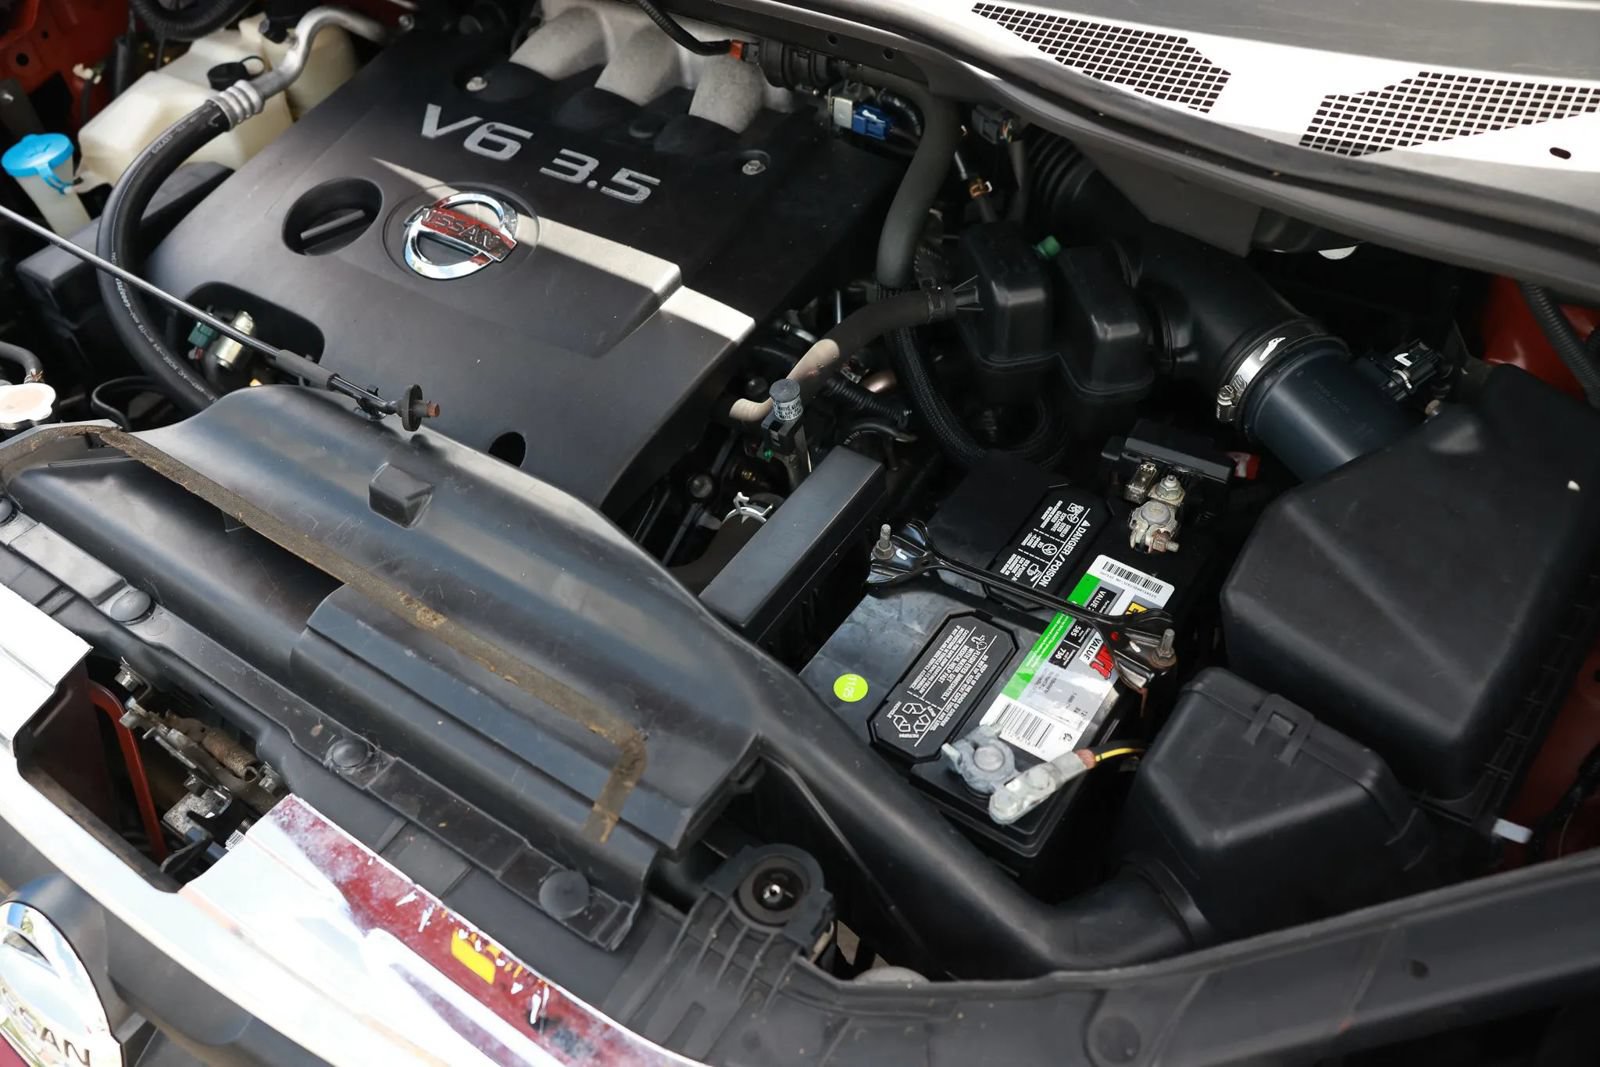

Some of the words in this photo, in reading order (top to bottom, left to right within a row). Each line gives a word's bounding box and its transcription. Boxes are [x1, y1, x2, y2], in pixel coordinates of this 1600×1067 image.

[421, 103, 534, 161] V6
[539, 148, 661, 204] 3.5
[416, 208, 501, 249] NISSAN
[1061, 527, 1086, 556] DANGER
[1038, 560, 1063, 587] POISON
[1090, 590, 1106, 608] VALUE
[1070, 625, 1082, 636] 585
[1055, 647, 1066, 659] 730
[1083, 638, 1102, 660] VALUE
